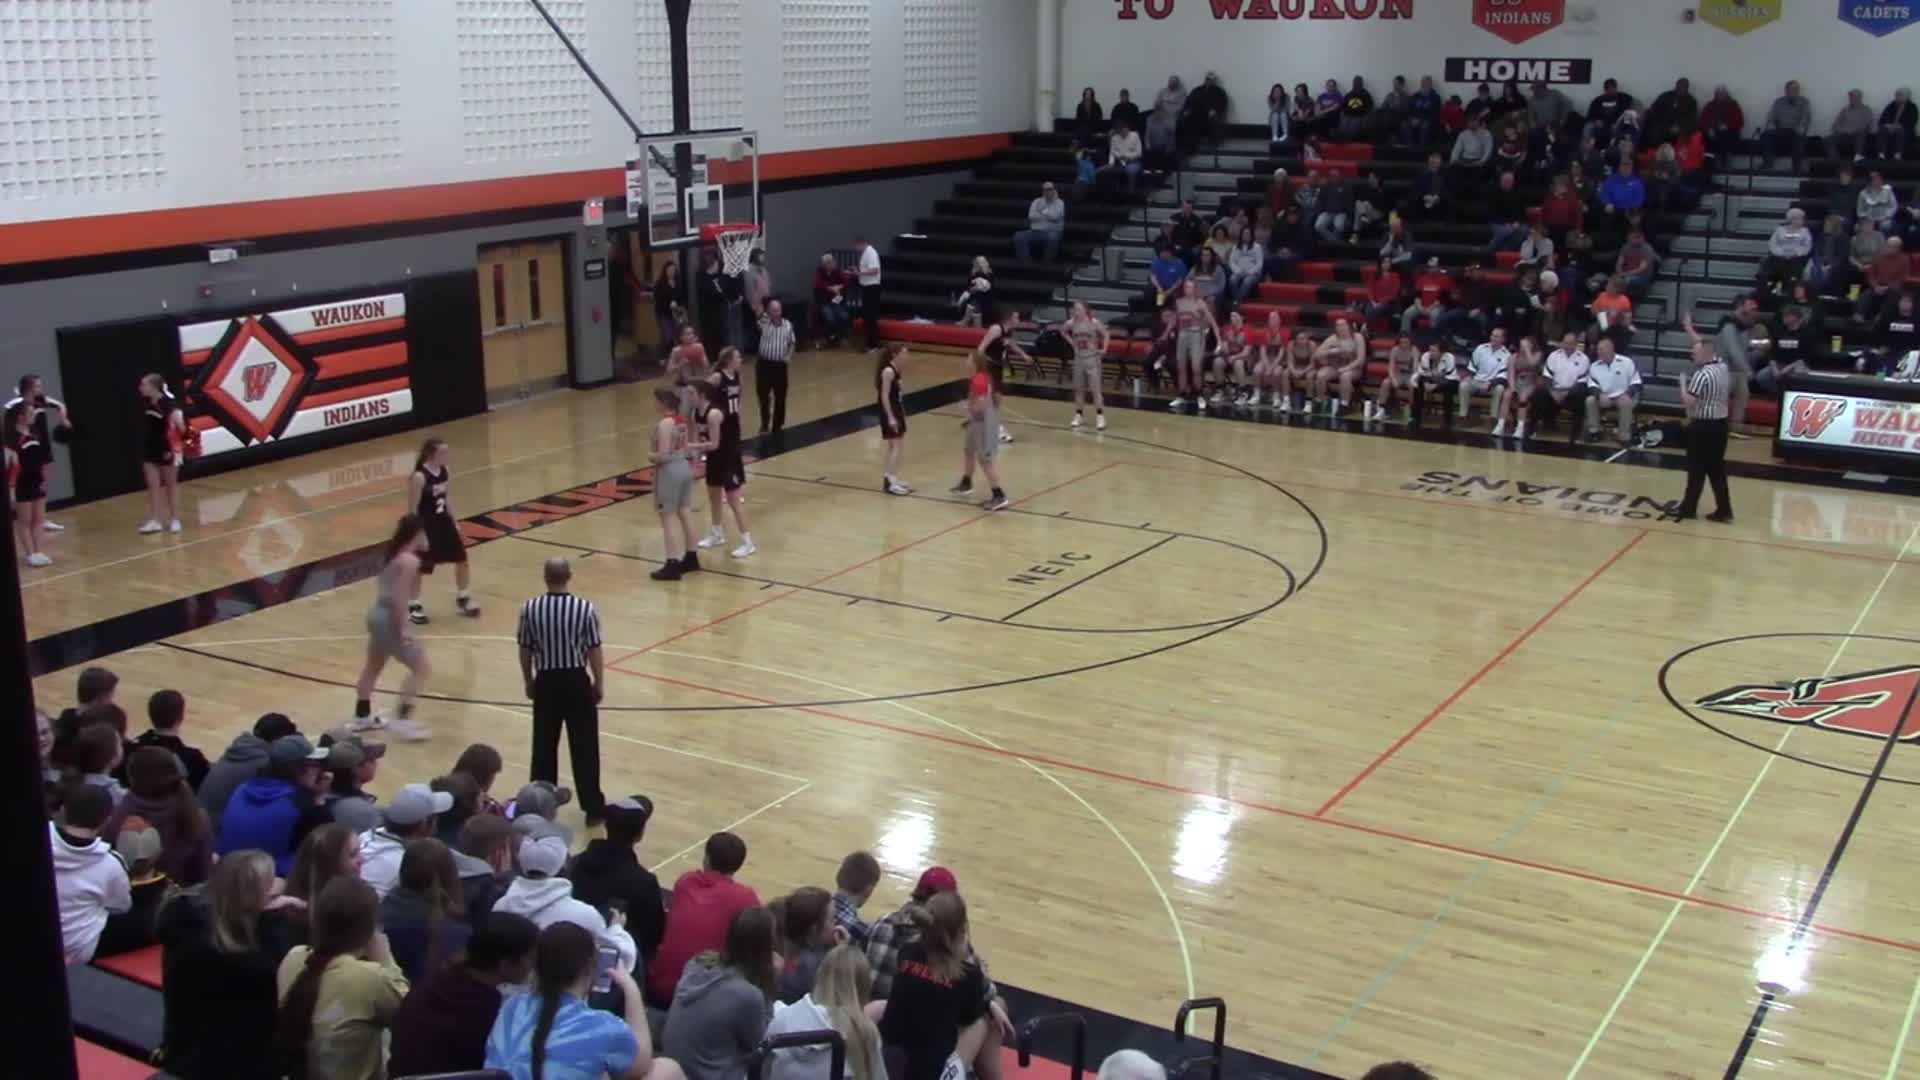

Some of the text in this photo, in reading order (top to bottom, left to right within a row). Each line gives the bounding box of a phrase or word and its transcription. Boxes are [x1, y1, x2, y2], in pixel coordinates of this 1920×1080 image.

[1485, 12, 1552, 25] INDIANS
[1852, 6, 1910, 20] CADETS
[1463, 60, 1572, 82] HOME
[311, 300, 386, 328] WAUKON
[241, 361, 278, 404] W
[323, 399, 391, 428] INDIANS
[1007, 550, 1092, 586] NEIC
